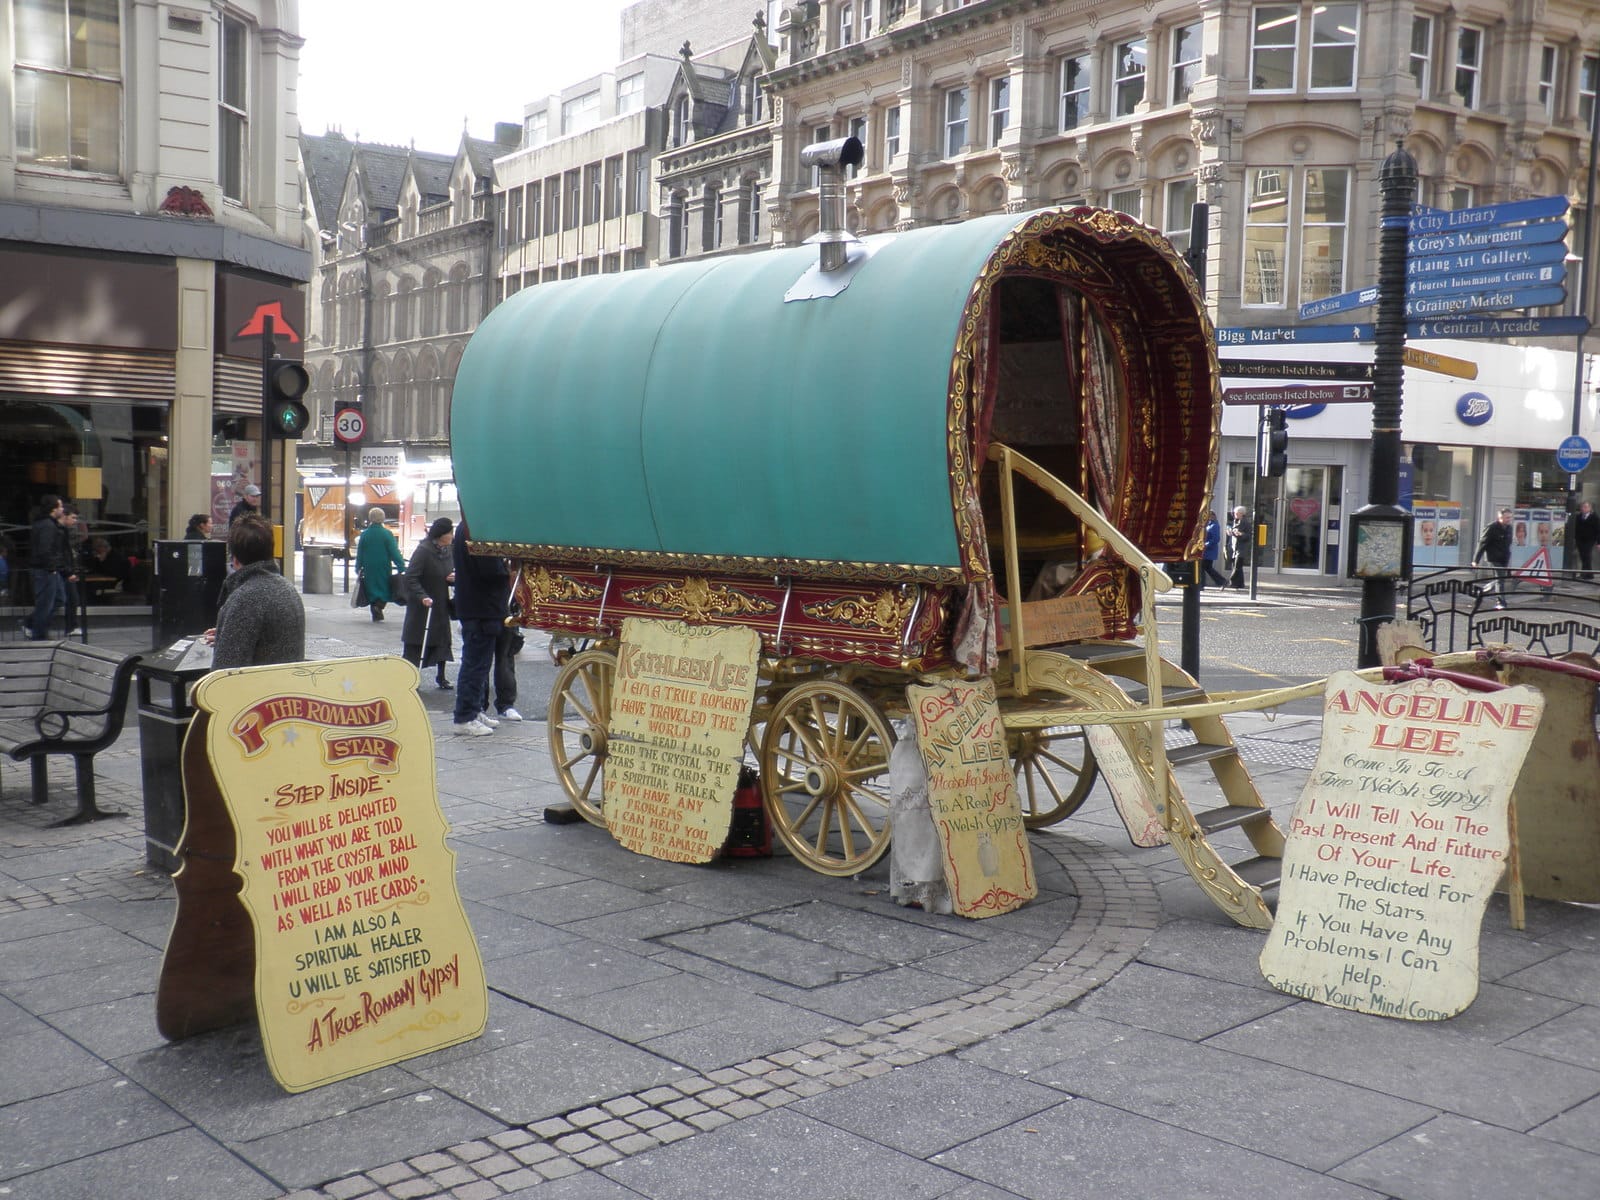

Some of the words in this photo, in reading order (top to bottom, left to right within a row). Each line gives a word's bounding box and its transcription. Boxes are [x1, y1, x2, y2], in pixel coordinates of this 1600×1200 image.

[1418, 216, 1444, 232] City
[1449, 208, 1497, 228] Library
[1418, 236, 1454, 251] Grey's
[1417, 259, 1450, 272] Laing
[1455, 255, 1474, 268] Art
[1417, 279, 1447, 291] Tourist
[1415, 296, 1467, 313] Grainger
[1470, 293, 1513, 307] Market
[1218, 330, 1246, 343] Bigg
[1251, 329, 1295, 341] Market
[1433, 320, 1483, 334] Central
[1489, 319, 1540, 333] Arcade
[1238, 364, 1281, 375] locations
[1282, 365, 1307, 376] listed
[1308, 366, 1336, 376] below
[1229, 392, 1242, 400] see
[1243, 390, 1282, 400] locations
[1284, 390, 1308, 400] listed
[1309, 389, 1335, 399] below
[339, 418, 362, 432] 30
[362, 455, 401, 466] FORBIDDE
[708, 650, 750, 692] LEE
[266, 699, 303, 720] THE
[307, 701, 382, 725] ROMANY
[664, 686, 698, 705] TRUE
[700, 692, 749, 713] ROMANY
[1328, 690, 1537, 730] ANGELINE
[620, 698, 647, 715] HAVE
[650, 703, 707, 726] TRAVELED
[711, 713, 738, 733] THE
[648, 720, 692, 739] WORLD
[923, 682, 997, 768] ANGELINE
[333, 739, 389, 758] STAR
[612, 742, 636, 755] READ
[639, 746, 658, 761] THE
[661, 751, 701, 769] CRYSTAL
[707, 759, 732, 776] THE
[651, 736, 677, 750] READ
[690, 743, 721, 758] ALSO
[959, 740, 1003, 764] LEE
[607, 755, 635, 769] STARS
[651, 762, 670, 777] THE
[673, 767, 707, 784] CARDS
[1343, 753, 1385, 770] Come
[1389, 758, 1412, 774] In
[1418, 761, 1444, 778] To
[1448, 766, 1477, 780] A
[275, 783, 325, 807] STEP
[329, 774, 383, 800] INSIDE
[605, 779, 617, 792] IF
[621, 783, 639, 796] YOU
[643, 789, 670, 805] HAVE
[678, 800, 705, 813] ANY
[623, 770, 669, 791] SPIRITUAL
[675, 782, 721, 803] HEALER
[1359, 776, 1420, 797] Welsh
[1423, 784, 1489, 811] Gypsy
[627, 798, 683, 821] PROBLEMS
[936, 798, 948, 813] To
[952, 797, 963, 812] A
[965, 793, 991, 810] Real
[1309, 799, 1316, 814] I
[1326, 801, 1360, 820] Will
[1371, 806, 1400, 825] Tell
[1411, 811, 1444, 831] You
[1454, 816, 1489, 836] The
[266, 826, 291, 846] YOU
[292, 818, 318, 839] WILL
[318, 813, 333, 831] BE
[338, 796, 397, 826] DELIGHTED
[622, 811, 645, 825] CAN
[649, 816, 680, 833] HELP
[685, 825, 710, 841] YOU
[948, 815, 983, 832] Welsh
[986, 813, 1022, 834] Gypsy
[261, 847, 293, 871] WITH
[294, 837, 324, 861] WHAT
[326, 832, 347, 852] YOU
[351, 825, 371, 845] ARE
[374, 816, 403, 837] TOLD
[621, 823, 647, 840] WILL
[651, 831, 665, 844] BE
[668, 836, 715, 857] AMAZED
[627, 839, 645, 852] MY
[652, 845, 697, 863] POWERS
[1292, 819, 1326, 838] Past
[1332, 825, 1397, 847] Present
[1402, 834, 1437, 852] And
[1445, 839, 1502, 861] Future
[277, 864, 310, 888] FROM
[311, 857, 336, 877] THE
[336, 843, 384, 869] CRYSTAL
[389, 833, 417, 855] BALL
[1317, 844, 1342, 861] Of
[1351, 848, 1400, 870] Your
[1410, 857, 1456, 879] Life.
[273, 894, 279, 911] I
[281, 886, 310, 909] WILL
[312, 876, 341, 899] READ
[344, 865, 375, 888] YOUR
[378, 855, 409, 879] MIND
[1289, 863, 1296, 878] I
[1299, 866, 1339, 885] Have
[1343, 870, 1429, 898] Predicted
[1438, 884, 1475, 904] For
[277, 912, 294, 933] AS
[299, 900, 334, 925] WELL
[336, 895, 353, 916] AS
[353, 886, 379, 909] THE
[1337, 893, 1367, 912] The
[1375, 898, 1427, 921] Stars.
[314, 929, 320, 945] I
[324, 923, 347, 943] AM
[351, 914, 387, 936] ALSO
[390, 911, 401, 927] A
[1296, 910, 1308, 932] If
[1318, 913, 1350, 933] You
[1360, 920, 1409, 942] Have
[1416, 929, 1453, 956] Any
[295, 942, 362, 972] SPIRITUAL
[370, 927, 423, 953] HEALER
[1284, 930, 1379, 961] Problems
[1386, 947, 1391, 963] I
[1401, 950, 1440, 973] Can
[289, 981, 301, 998] U
[304, 973, 341, 995] WILL
[344, 966, 362, 985] BE
[368, 949, 431, 979] SATISFIED
[1342, 963, 1386, 993] Help.
[307, 1017, 323, 1052] A
[321, 1006, 363, 1043] TRUE
[360, 975, 415, 1024] ROMANY
[419, 953, 459, 1004] GYPSY
[1264, 974, 1317, 998] Satisfy
[1324, 984, 1365, 1007] Your
[1370, 993, 1404, 1014] Mind
[1409, 1000, 1449, 1021] Come
